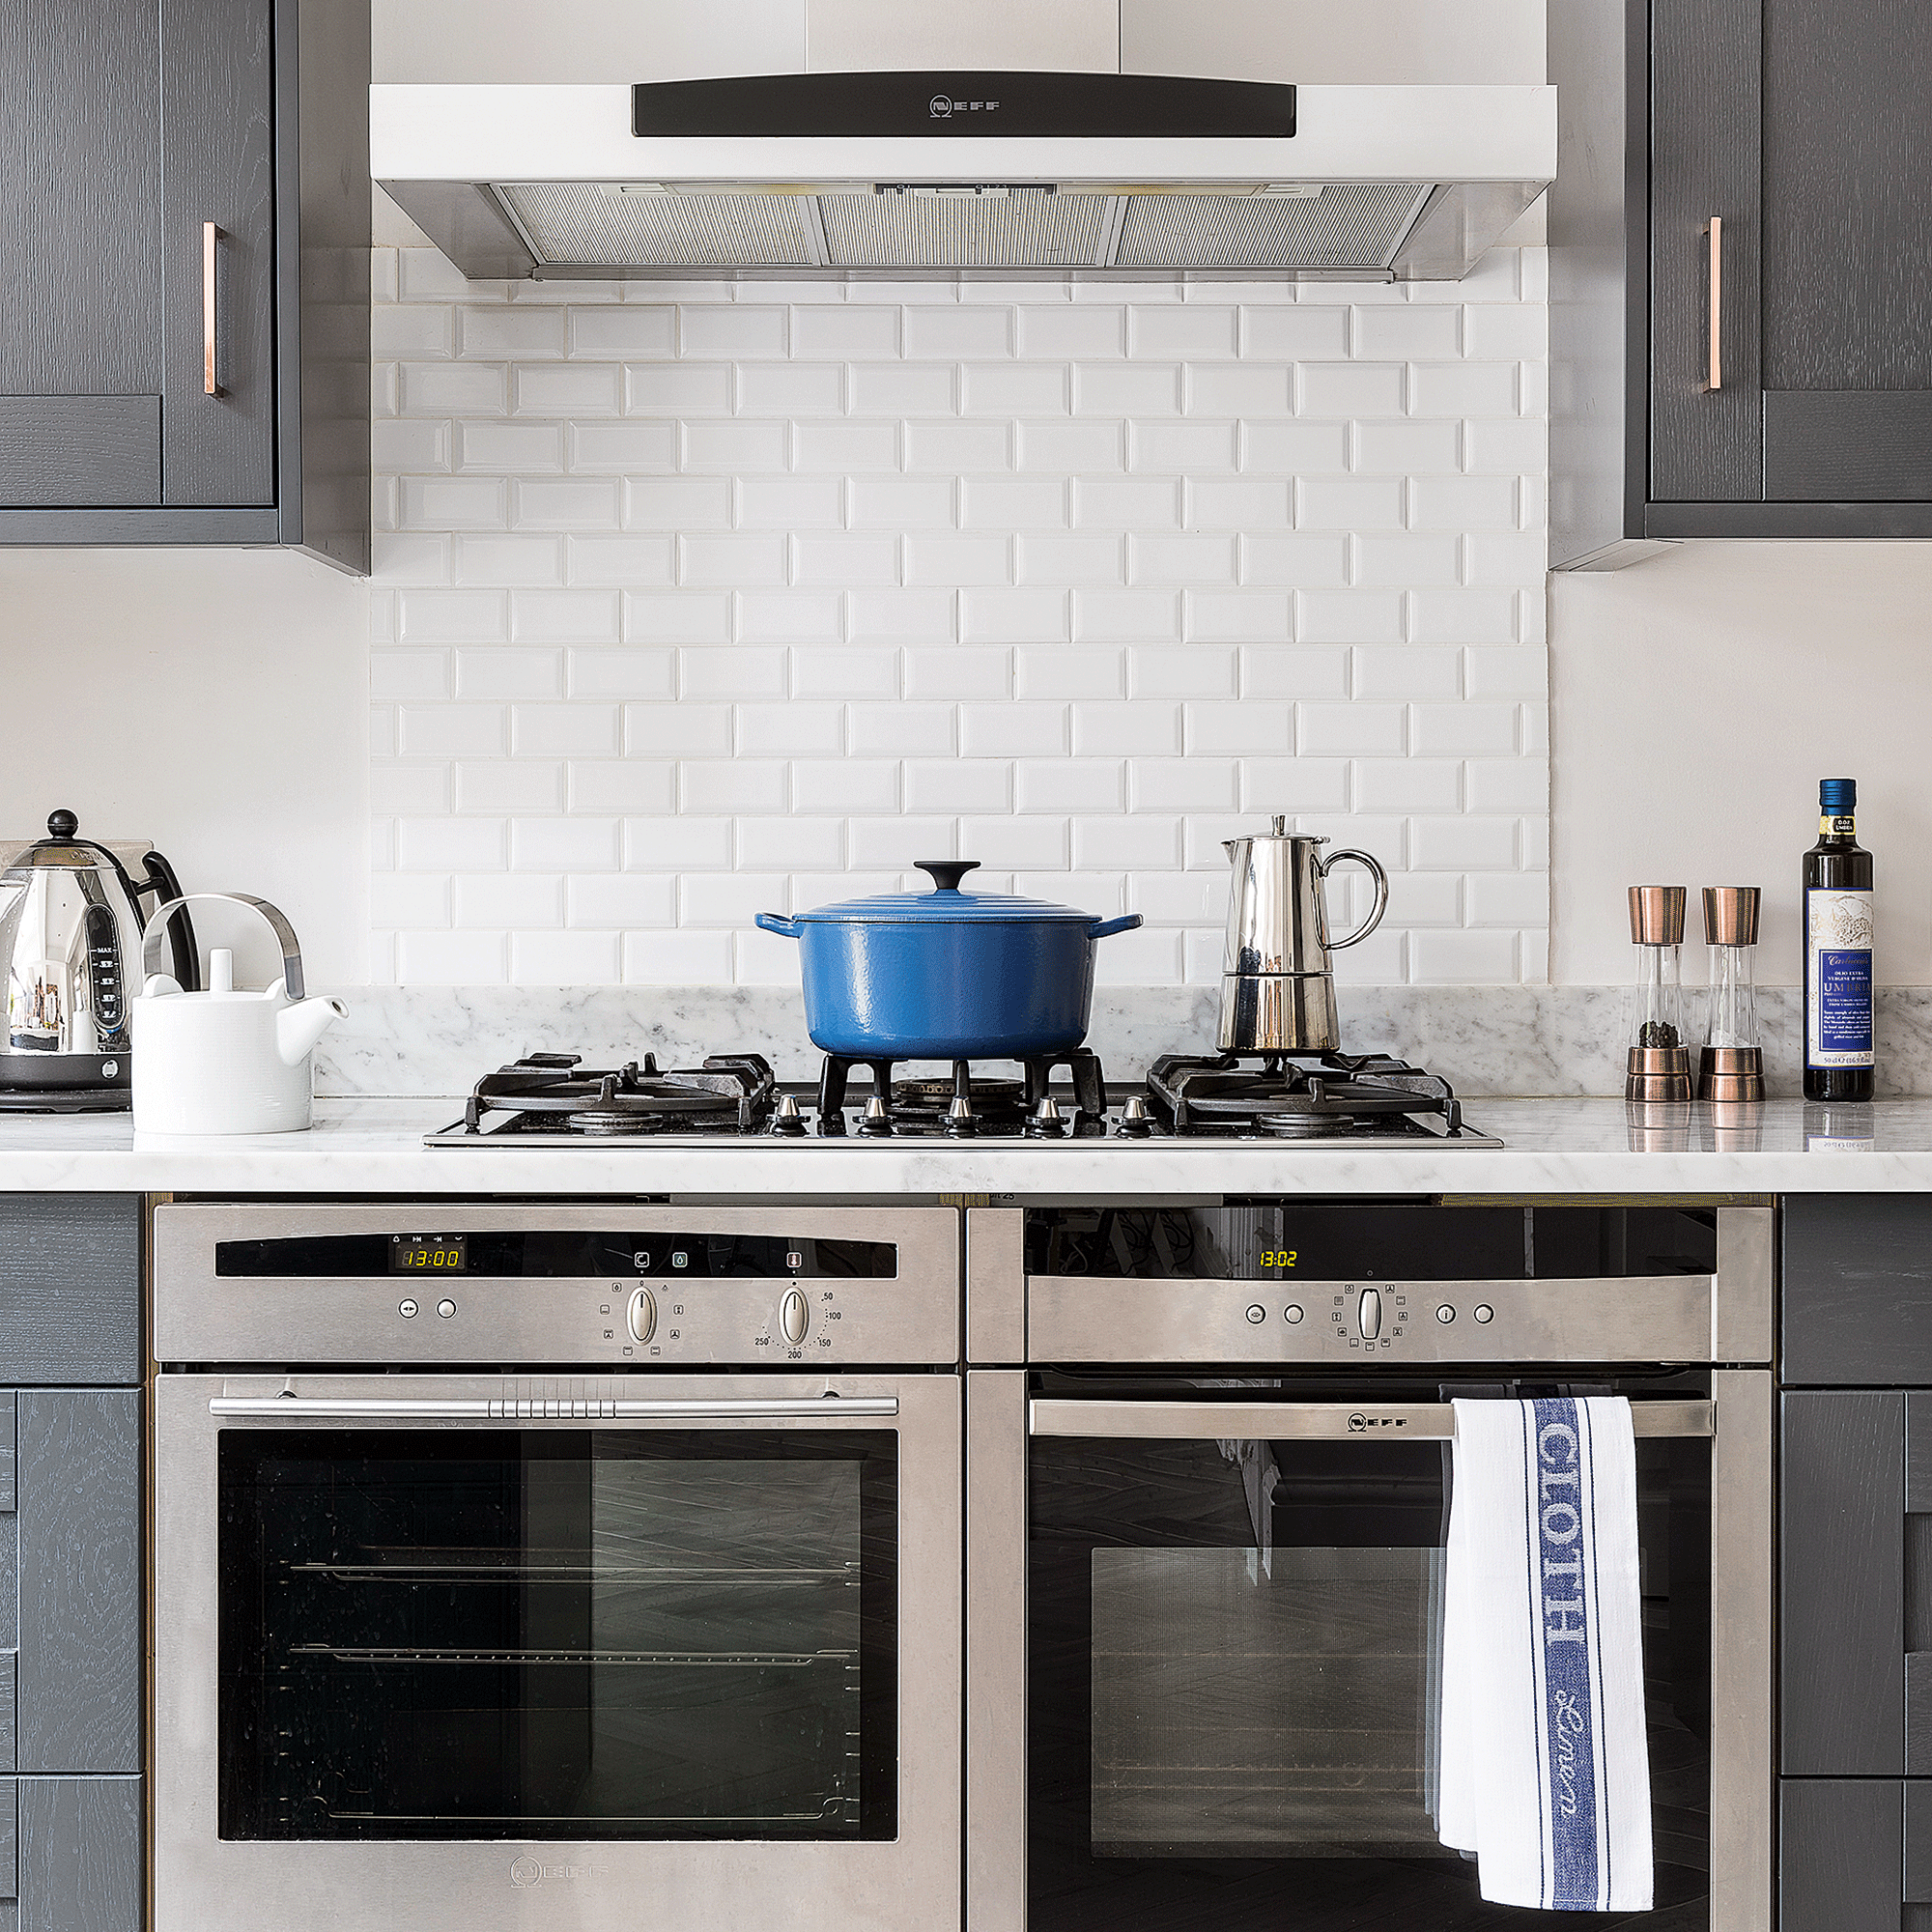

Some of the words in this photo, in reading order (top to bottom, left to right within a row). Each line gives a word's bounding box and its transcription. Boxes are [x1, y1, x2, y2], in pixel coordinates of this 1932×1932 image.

[929, 94, 1000, 118] NEFF
[408, 1250, 459, 1267] 13:00
[1260, 1250, 1298, 1267] 13:02
[823, 1292, 834, 1301] 50
[828, 1311, 842, 1321] 100
[754, 1337, 769, 1347] 250
[818, 1338, 832, 1348] 150
[787, 1350, 803, 1359] 200
[1348, 1412, 1407, 1432] NEFF
[1538, 1422, 1585, 1643] CLOTH
[1554, 1689, 1584, 1819] Linen
